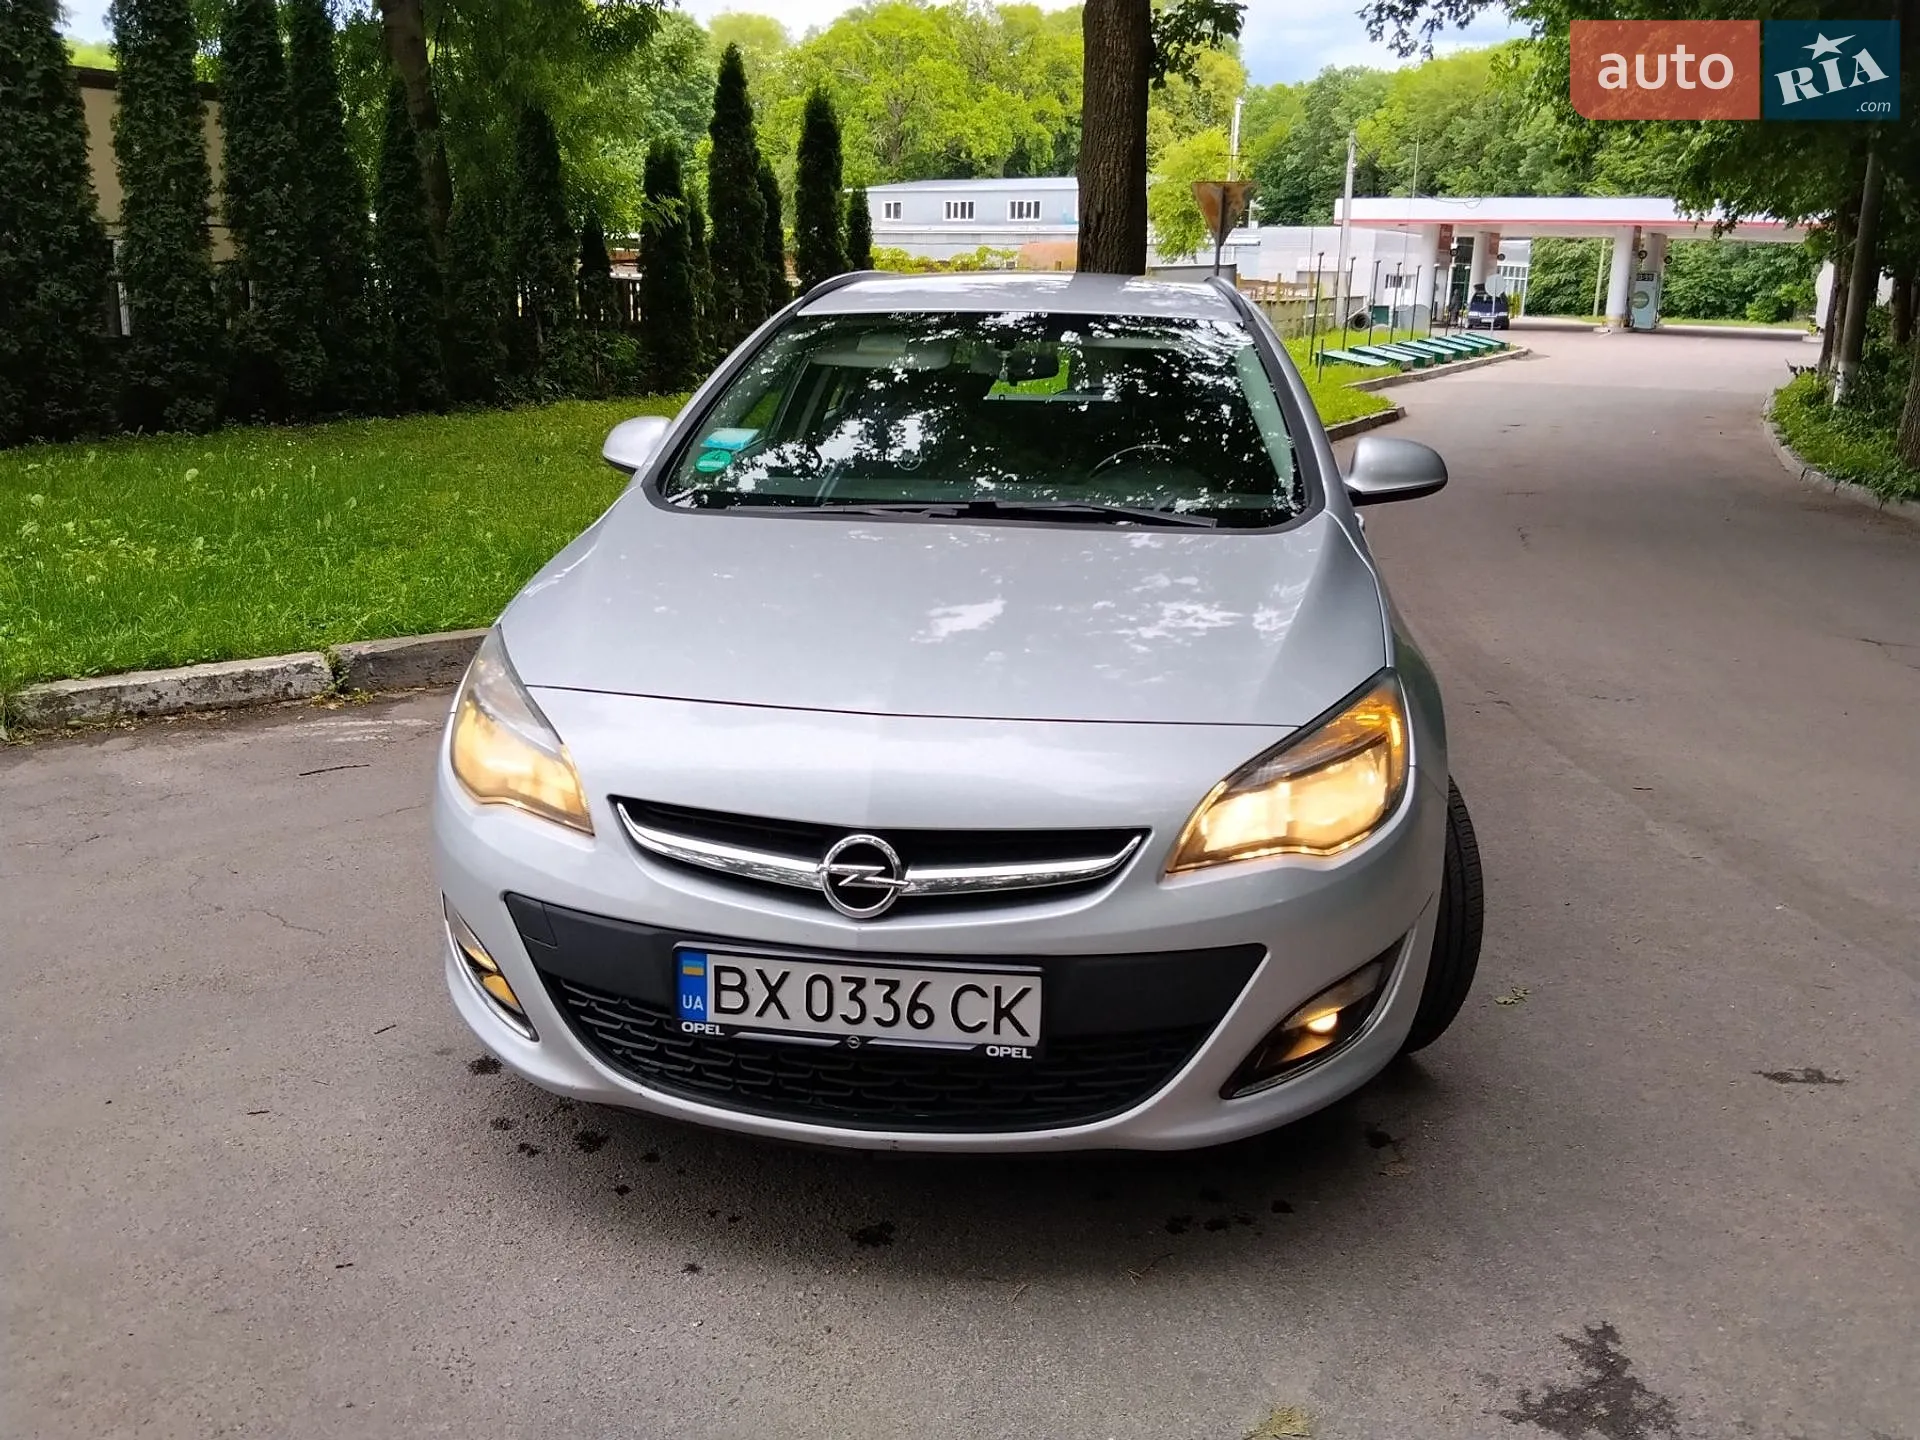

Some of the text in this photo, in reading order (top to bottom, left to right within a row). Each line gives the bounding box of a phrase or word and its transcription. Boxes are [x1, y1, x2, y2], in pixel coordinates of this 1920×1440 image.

[682, 994, 704, 1011] UA
[713, 965, 1032, 1037] BX 0336 CK
[681, 1021, 725, 1036] OPEL
[986, 1045, 1032, 1059] OPEL
